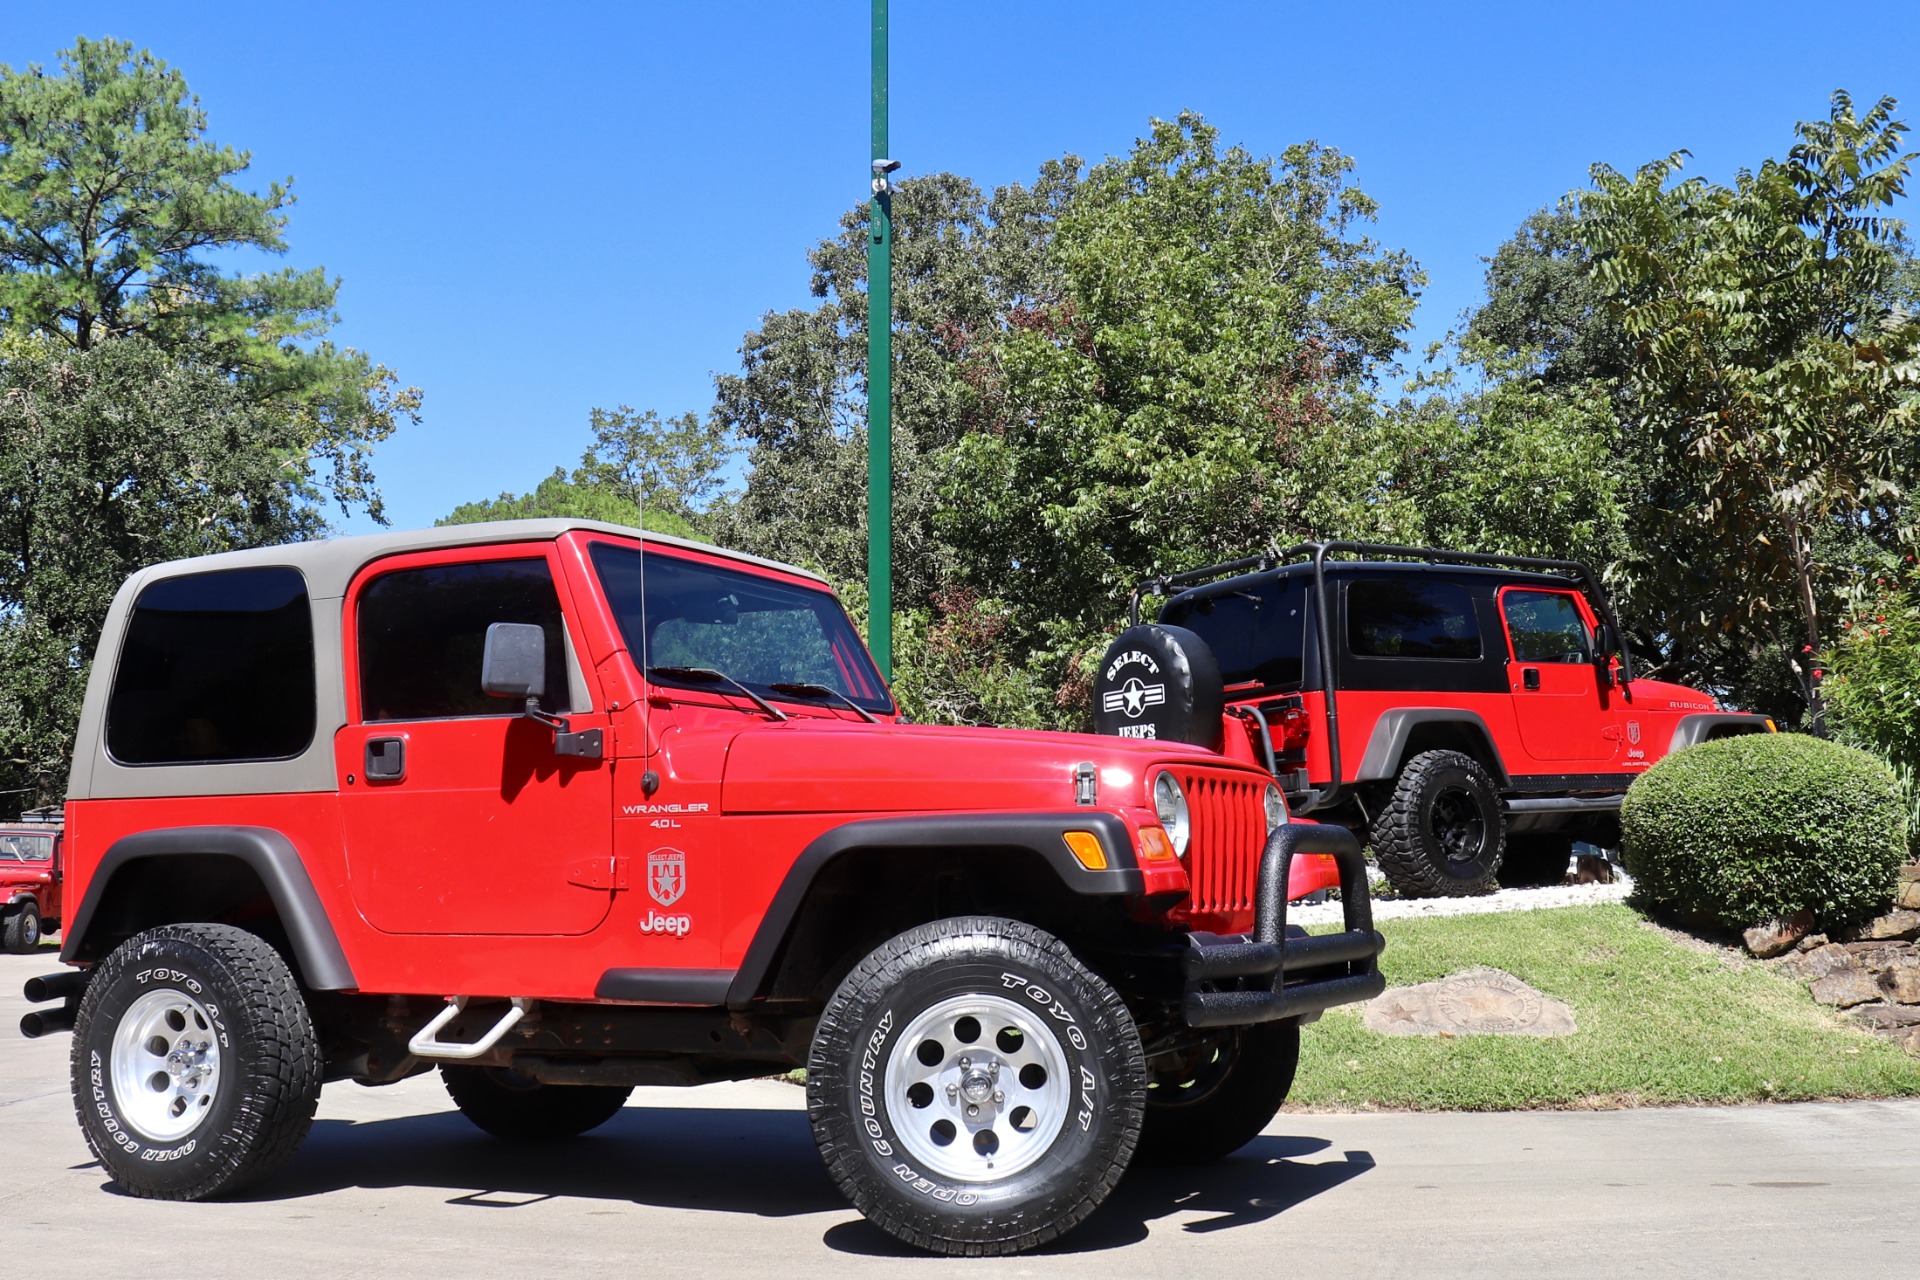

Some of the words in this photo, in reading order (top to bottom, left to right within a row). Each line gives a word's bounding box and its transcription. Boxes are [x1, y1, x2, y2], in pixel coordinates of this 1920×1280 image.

[1106, 650, 1160, 681] SELECT
[1669, 701, 1710, 710] RUBICON
[1627, 748, 1645, 760] Jeep
[622, 803, 709, 814] WRANGLER
[639, 910, 690, 937] Jeep
[136, 968, 202, 994] TOYO
[205, 1003, 229, 1048] A/T
[1000, 972, 1087, 1050] TOYO
[1078, 1065, 1095, 1132] A/T
[859, 1009, 893, 1156] COUNTRY
[91, 1050, 139, 1152] COUNTRY
[141, 1138, 197, 1161] OPEN
[893, 1163, 979, 1206] OPEN
